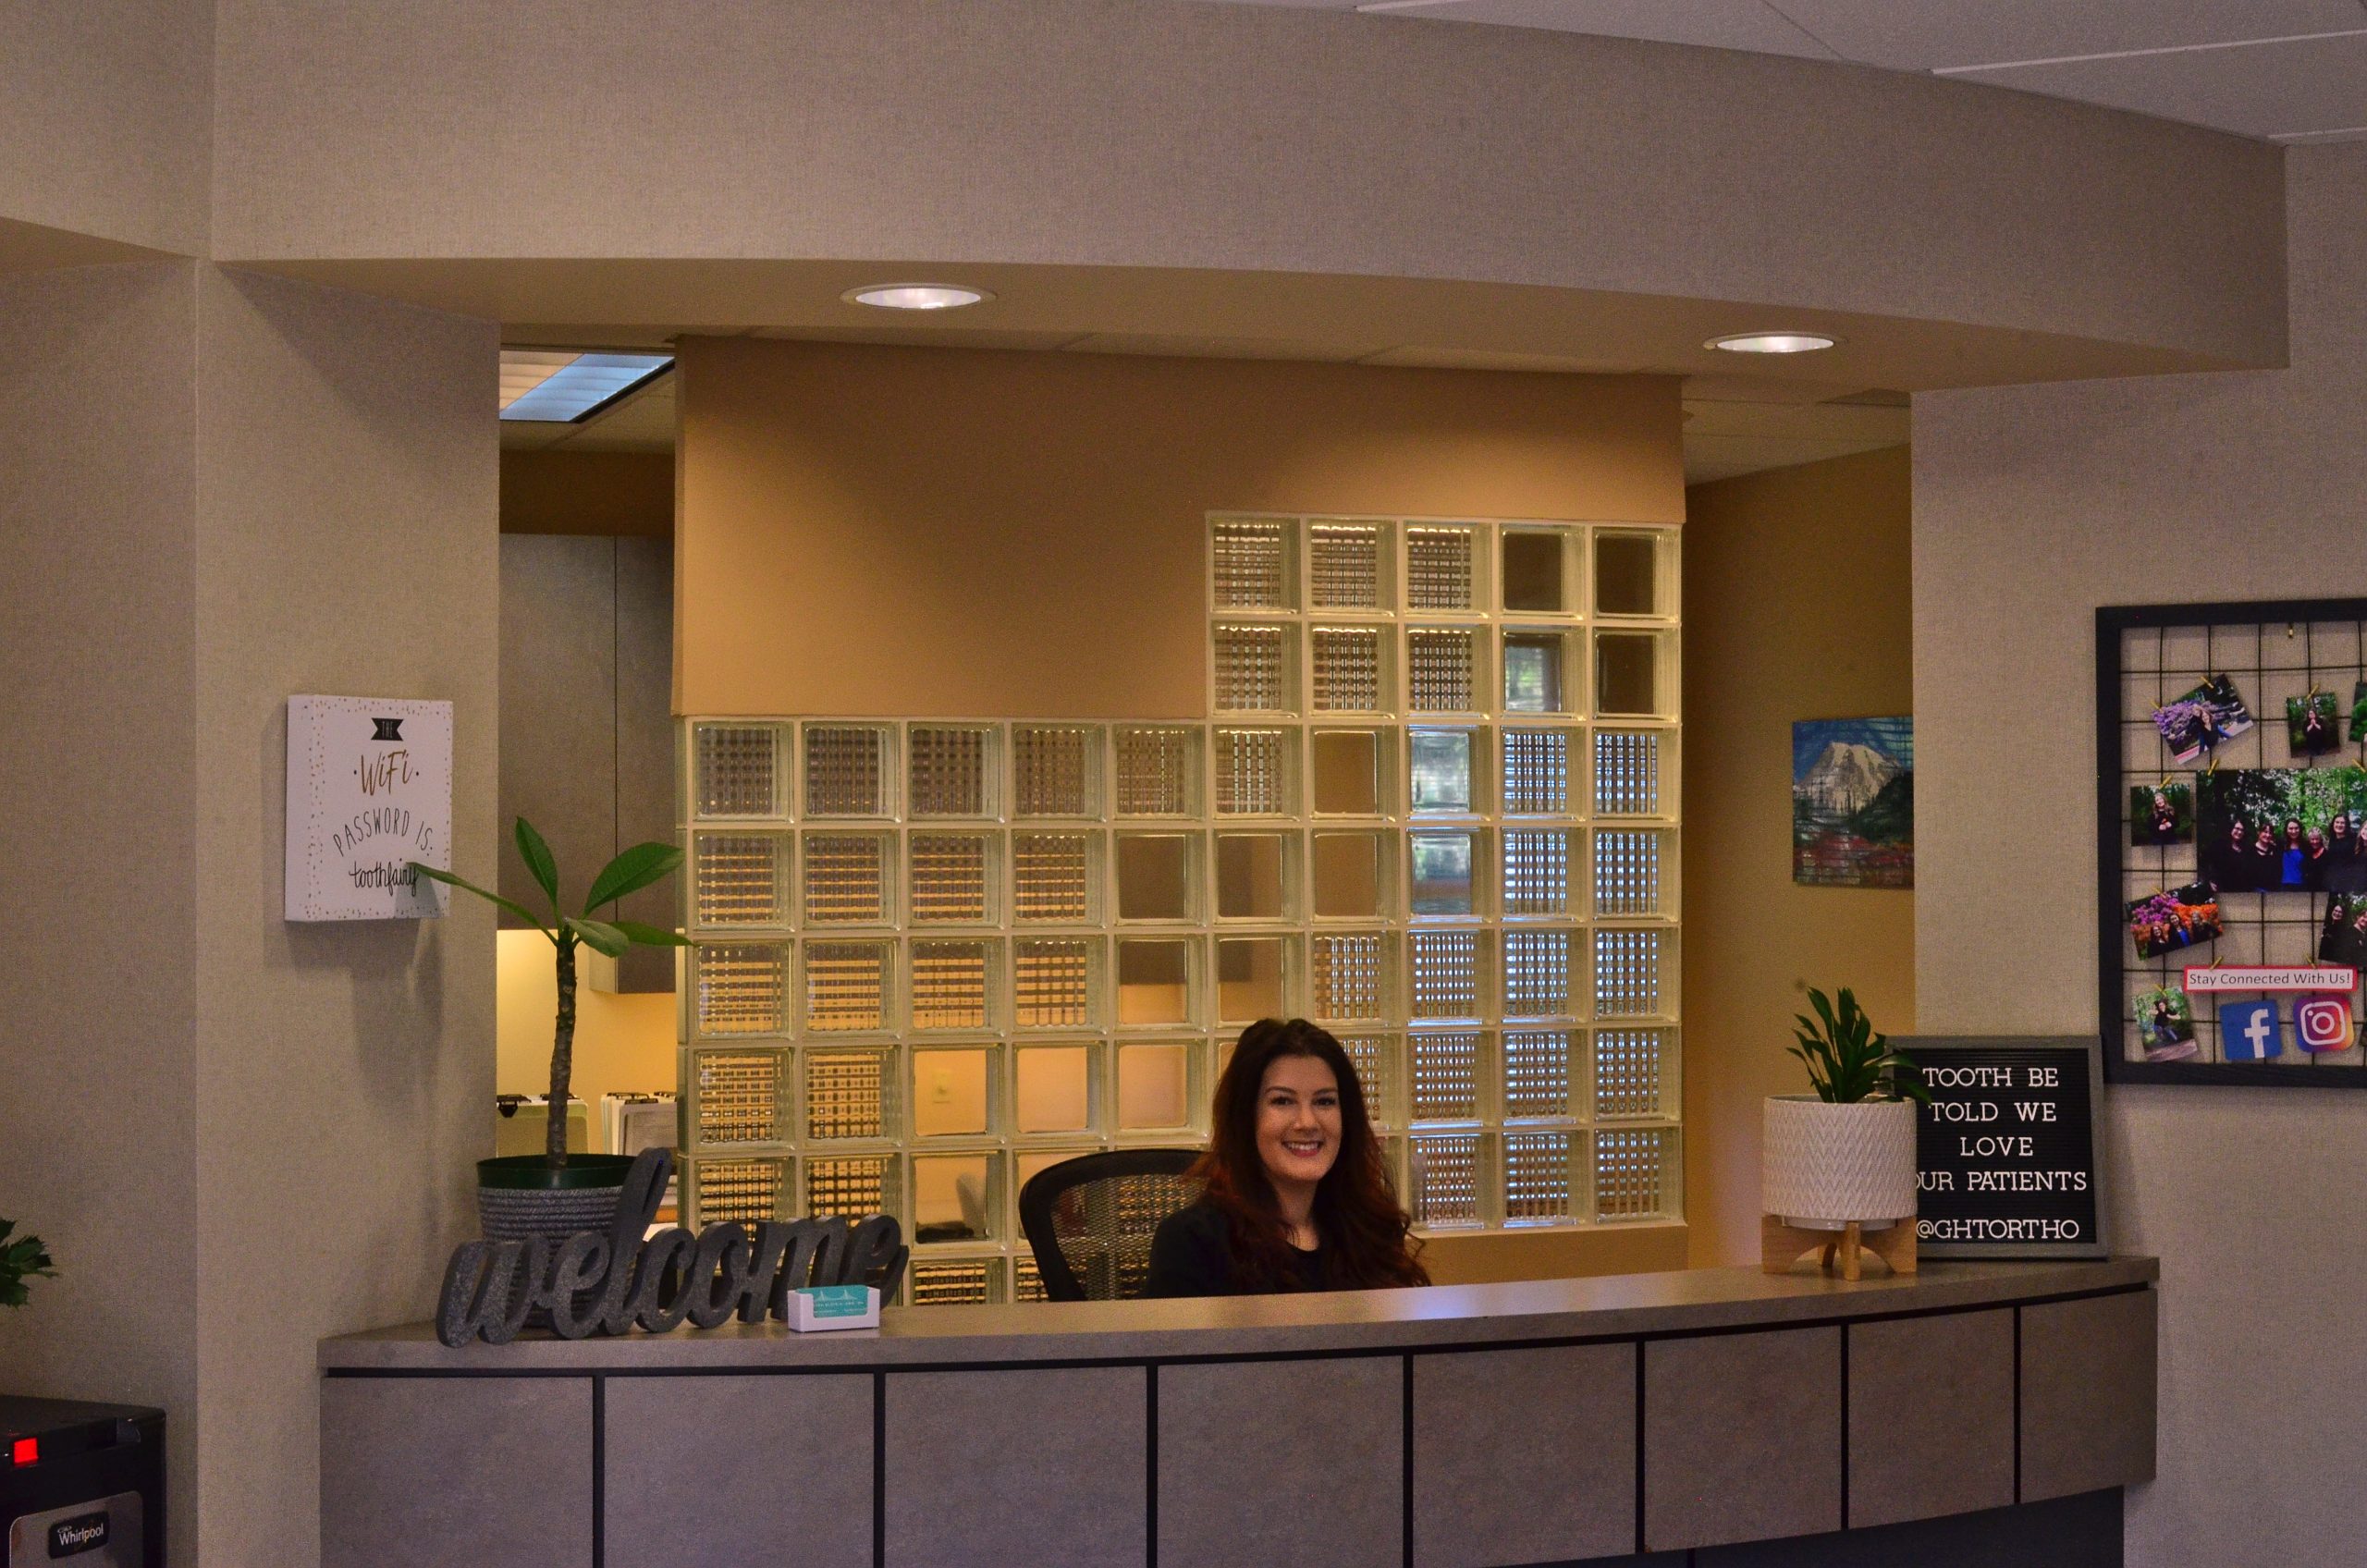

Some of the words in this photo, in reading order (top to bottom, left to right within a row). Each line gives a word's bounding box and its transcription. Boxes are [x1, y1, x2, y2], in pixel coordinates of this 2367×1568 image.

[361, 749, 414, 796] WiFi
[333, 807, 410, 857] PASSWORD
[349, 857, 420, 897] toothfairy
[2189, 974, 2216, 986] Stay
[2221, 973, 2289, 985] Connected
[2293, 972, 2324, 985] With
[2329, 973, 2350, 984] Us!
[1922, 1068, 2013, 1087] TOOTH
[2028, 1068, 2059, 1087] BE
[1928, 1102, 1999, 1121] TOLD
[2014, 1102, 2057, 1121] WE
[1960, 1137, 2033, 1157] LOVE
[1916, 1171, 1955, 1191] UR
[1967, 1171, 2087, 1191] PATIENTS
[1916, 1219, 2079, 1240] @GHTORTHO
[436, 1146, 909, 1348] welcome
[58, 1522, 104, 1546] Whirlpool
